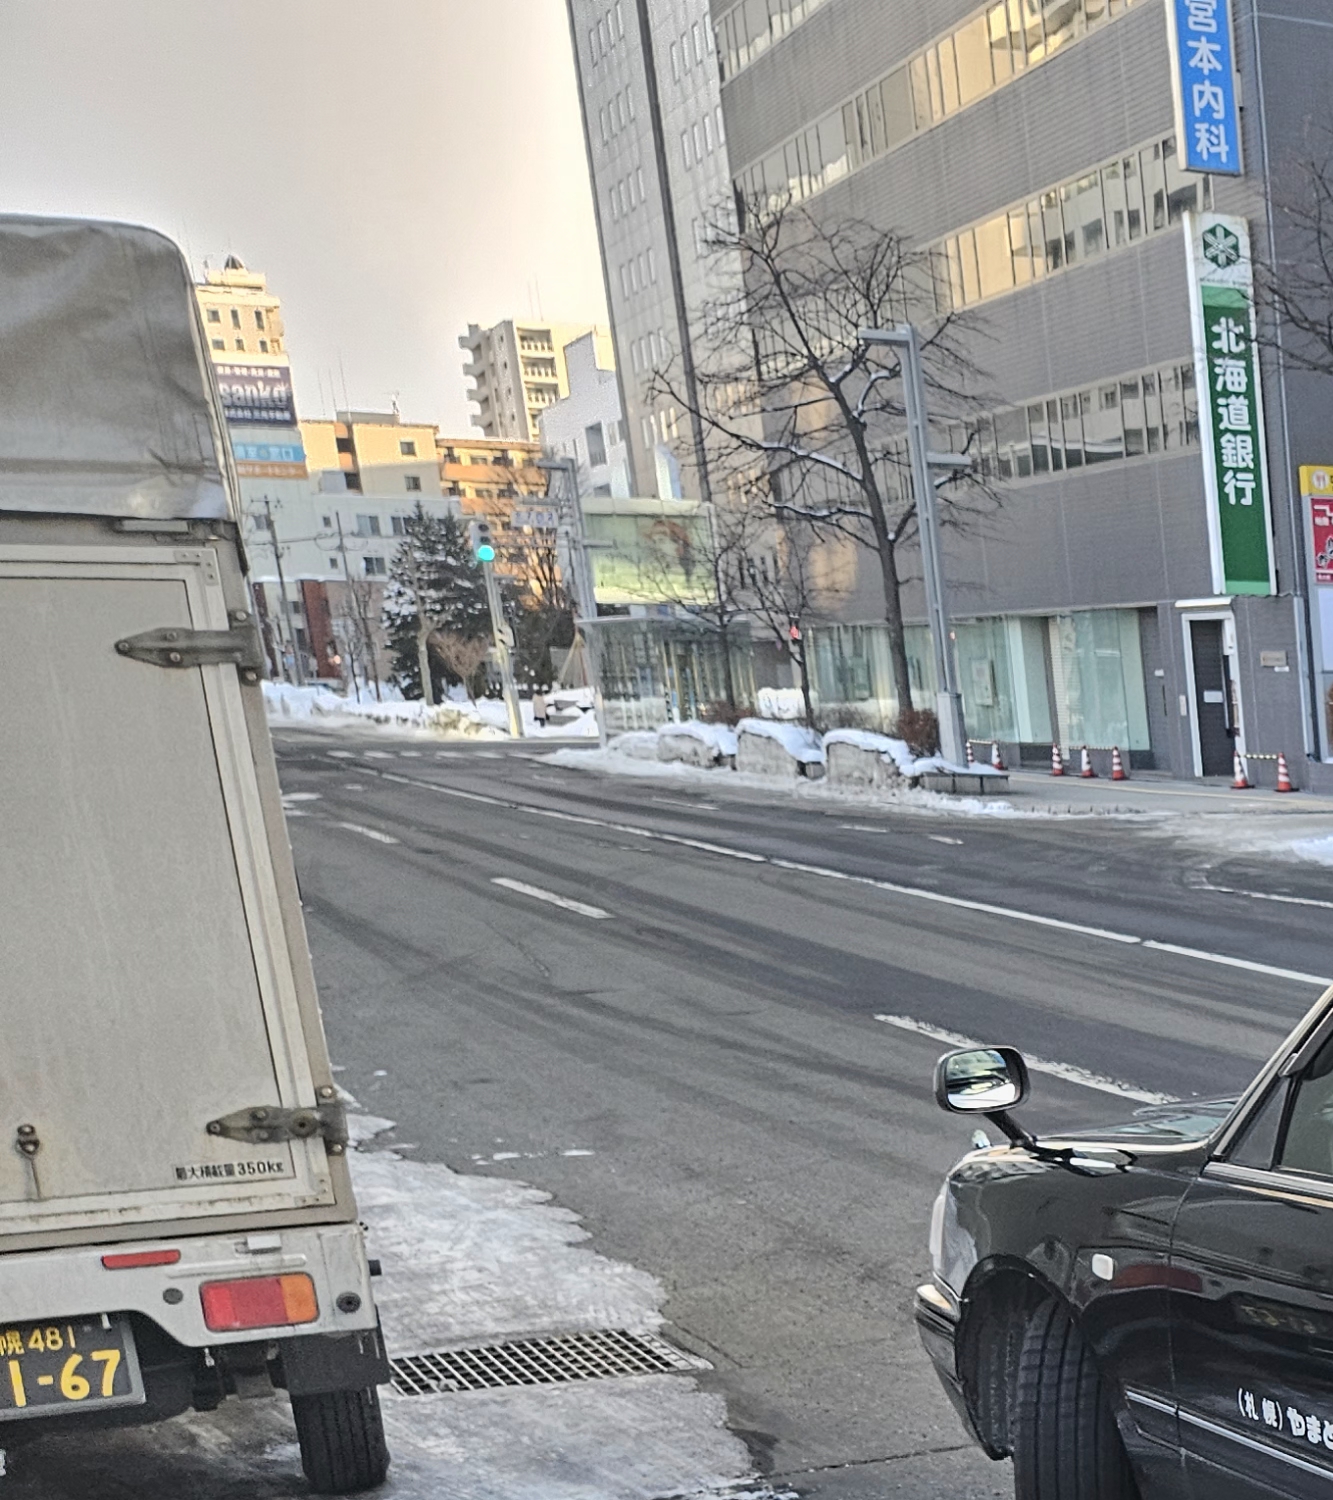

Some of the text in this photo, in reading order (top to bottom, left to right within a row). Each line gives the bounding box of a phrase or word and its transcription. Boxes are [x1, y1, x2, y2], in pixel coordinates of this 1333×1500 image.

[1184, 0, 1229, 163] 宮本内科
[1211, 316, 1256, 506] 北海道銀行
[8, 1349, 120, 1407] 1-67
[28, 1325, 76, 1352] 481
